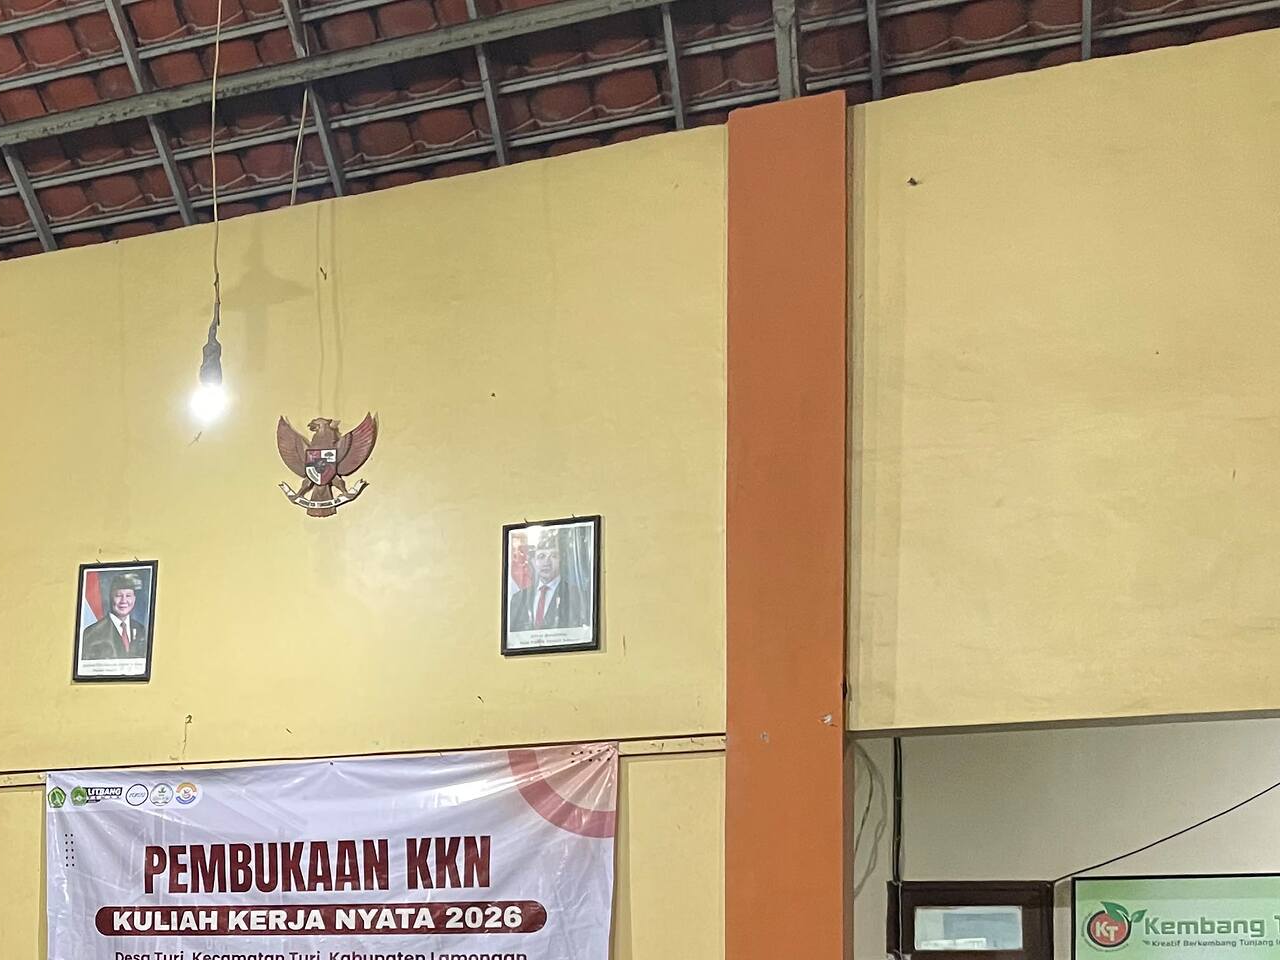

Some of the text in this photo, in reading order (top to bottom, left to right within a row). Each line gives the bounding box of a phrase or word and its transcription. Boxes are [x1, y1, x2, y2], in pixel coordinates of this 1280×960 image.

[144, 835, 491, 894] PEMBUKAAN KKN
[113, 906, 523, 931] KULIAH KERJA NYATA 2026
[1144, 917, 1265, 937] Kembang
[1095, 920, 1119, 941] KT
